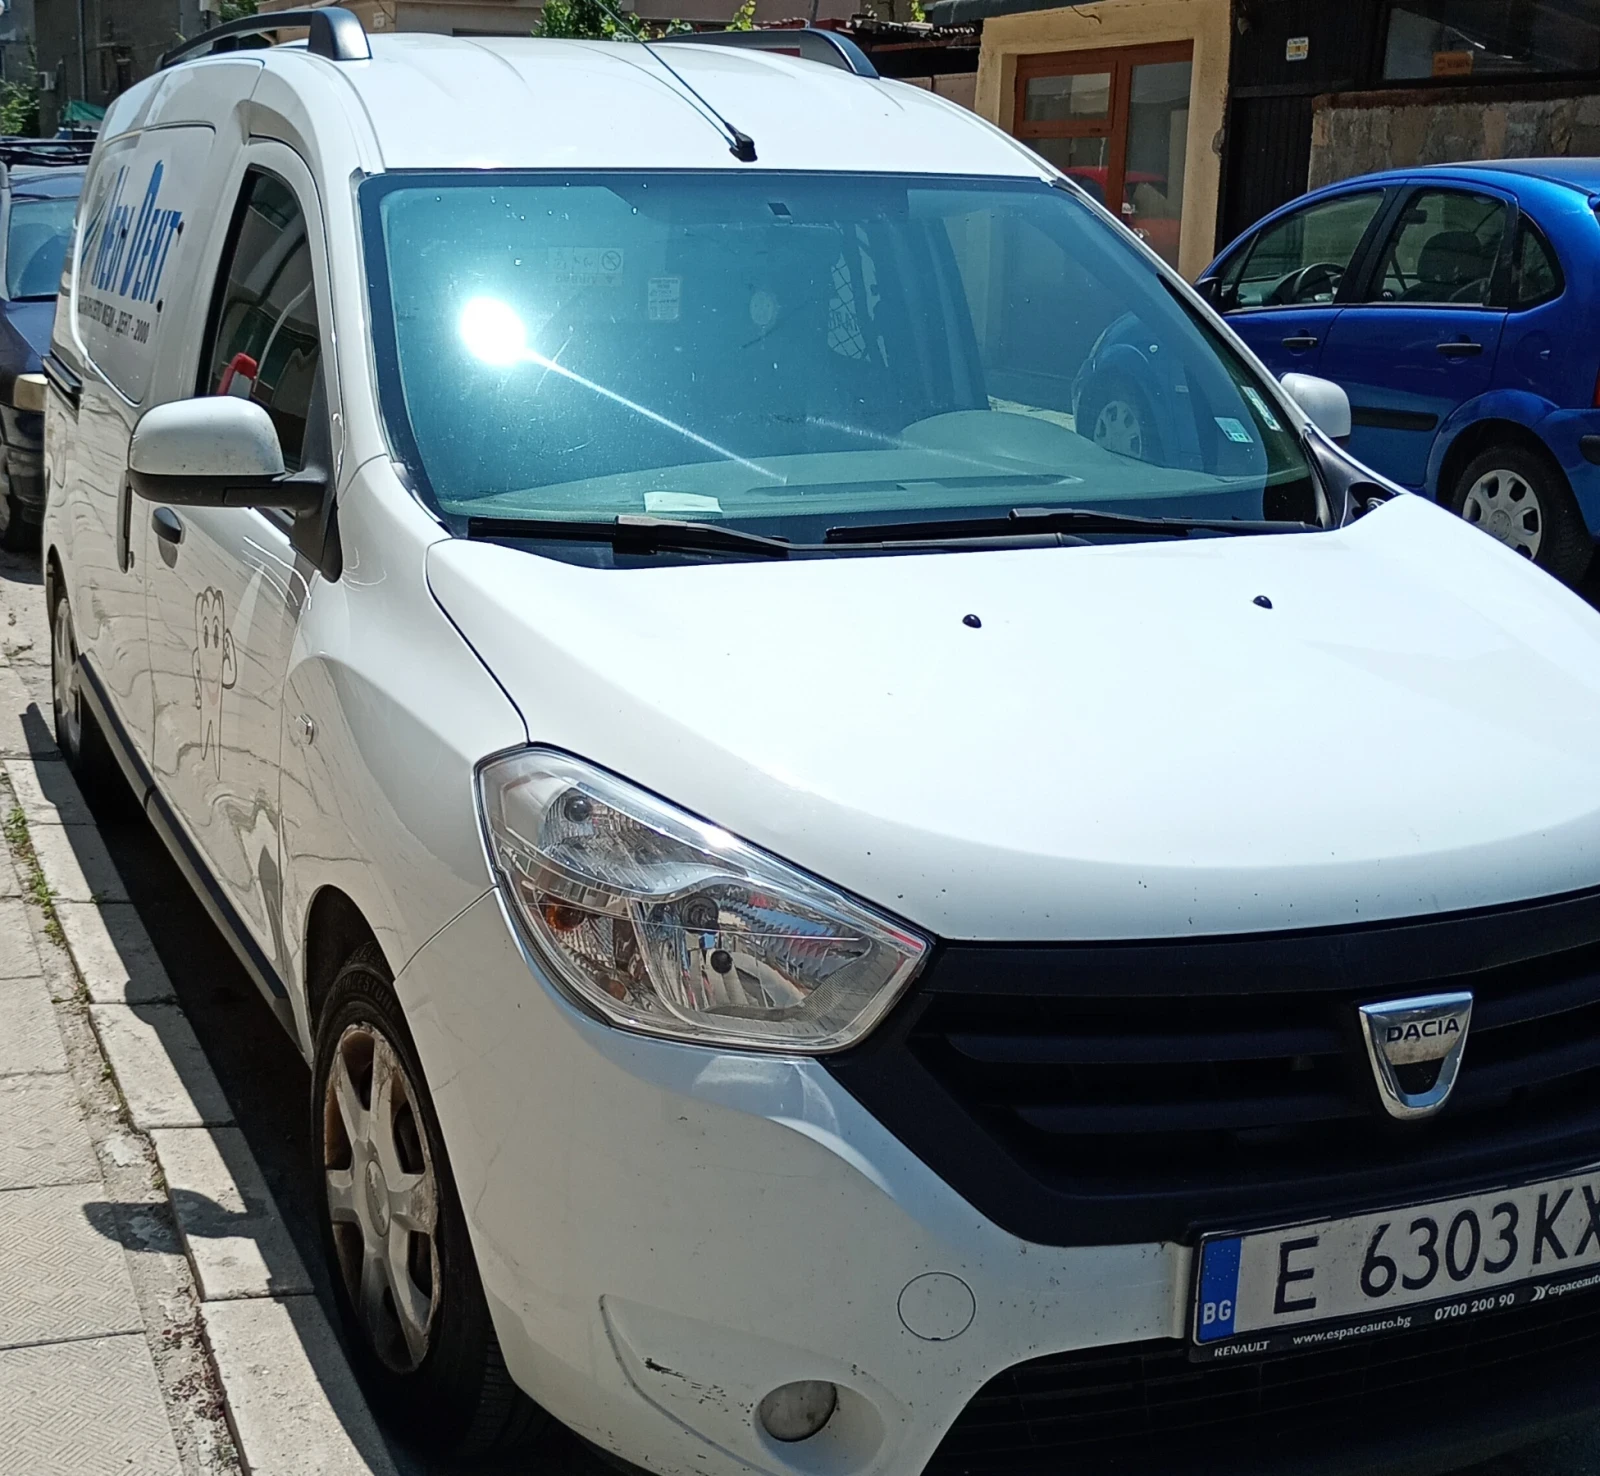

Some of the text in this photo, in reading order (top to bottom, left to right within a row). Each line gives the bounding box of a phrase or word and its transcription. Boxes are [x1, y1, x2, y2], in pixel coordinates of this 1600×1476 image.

[1386, 1018, 1459, 1042] DACIA
[1273, 1236, 1319, 1314] E
[1203, 1300, 1231, 1325] BG
[1292, 1274, 1600, 1345] www.espaceauto.bg 0700 200 90 espaceaut
[1214, 1341, 1270, 1357] RENAULT
